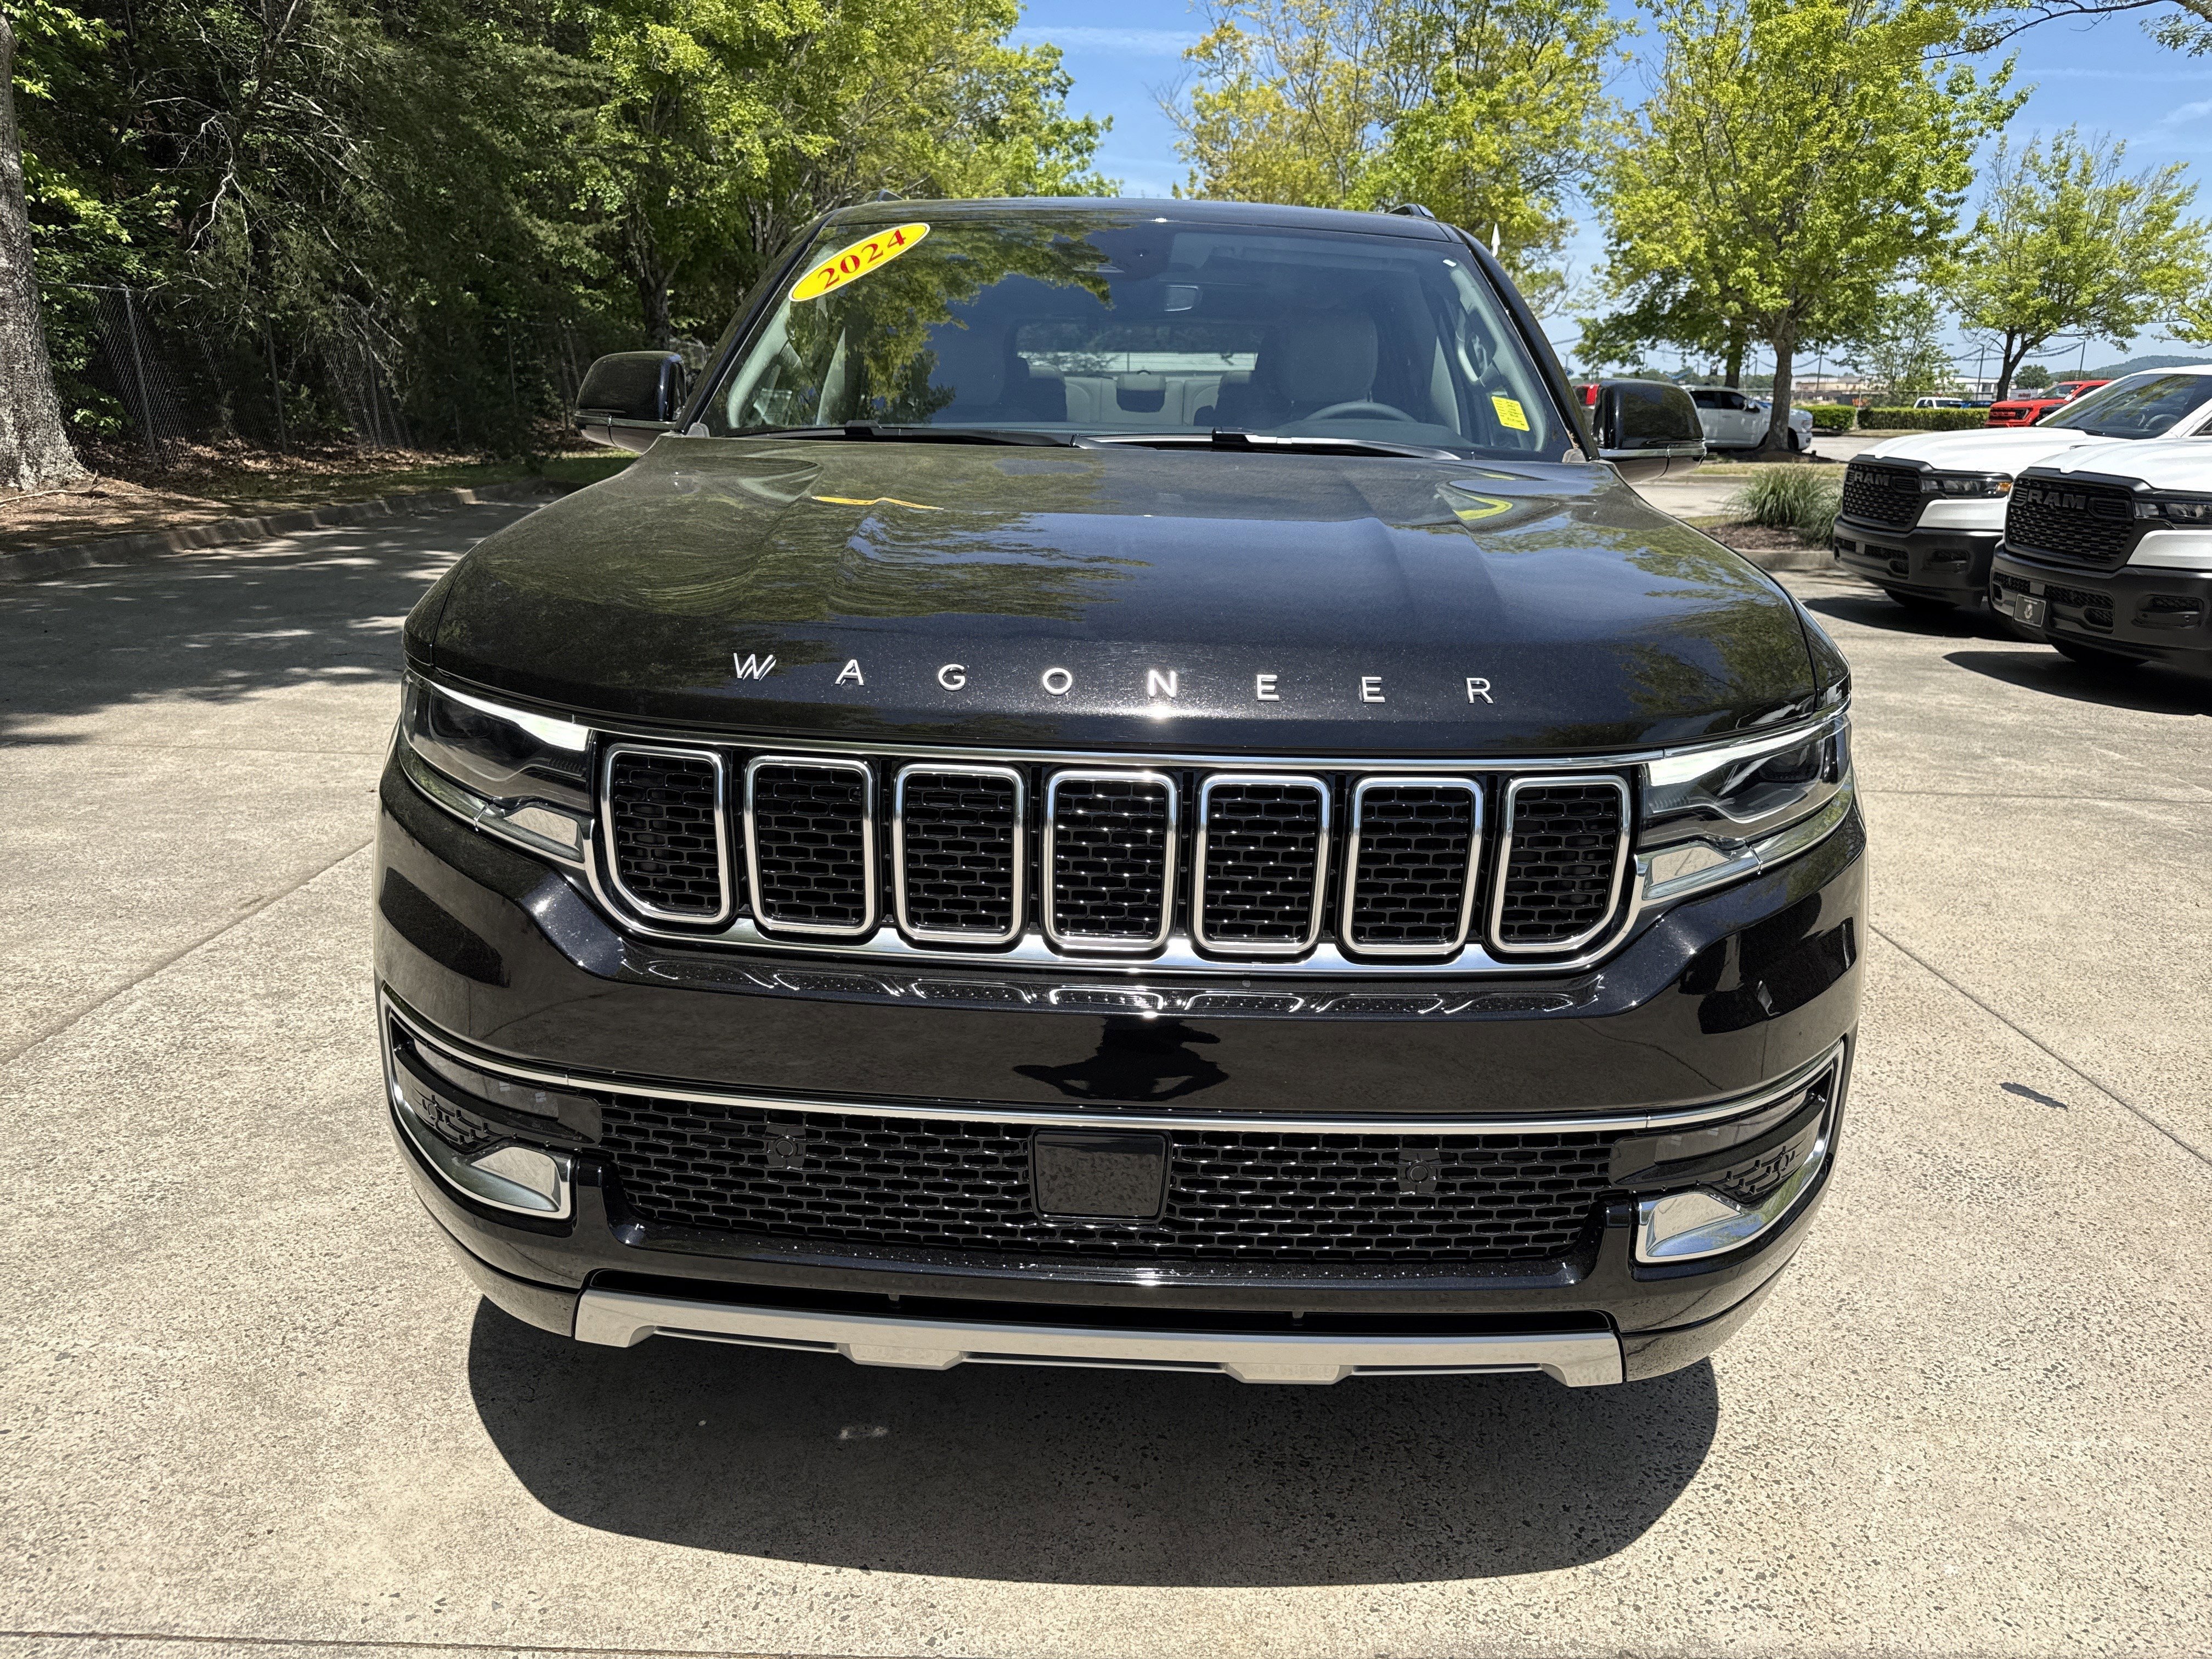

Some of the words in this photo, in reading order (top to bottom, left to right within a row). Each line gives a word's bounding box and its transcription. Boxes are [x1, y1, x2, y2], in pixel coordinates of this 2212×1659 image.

[817, 229, 907, 290] 2024
[1854, 471, 1890, 486] RAM
[2028, 489, 2086, 510] RAM
[733, 653, 1494, 704] WAGONEER
